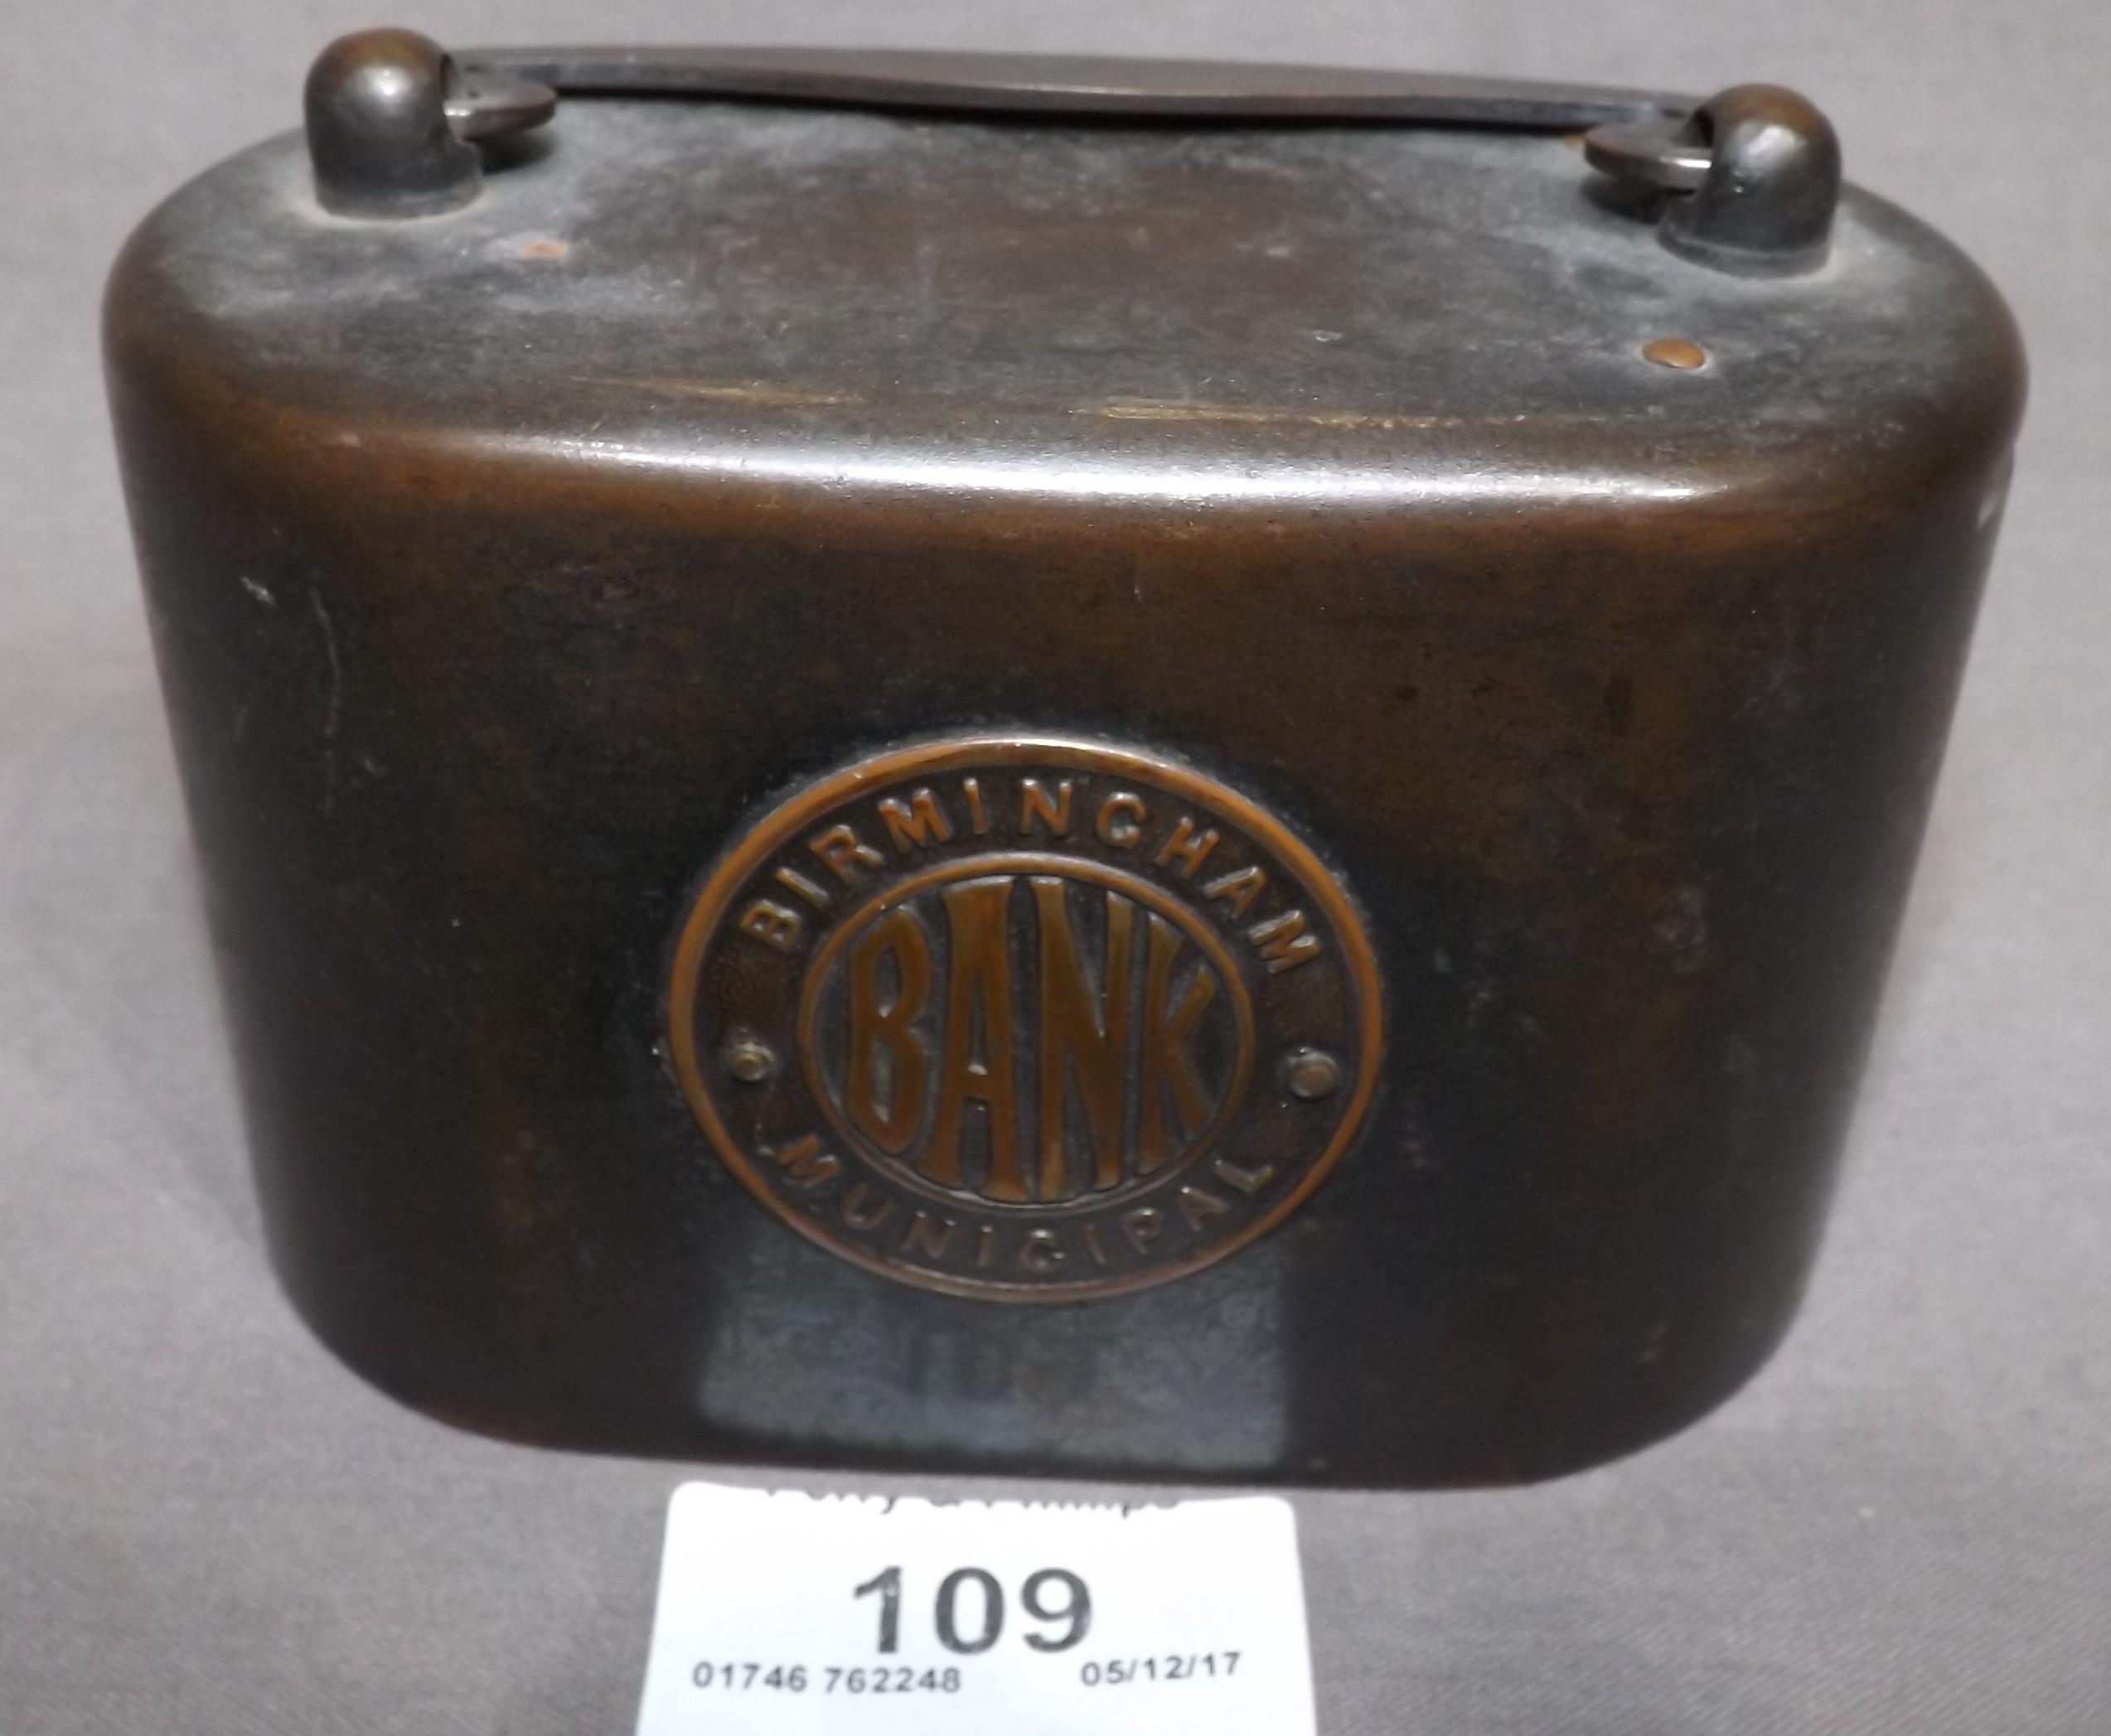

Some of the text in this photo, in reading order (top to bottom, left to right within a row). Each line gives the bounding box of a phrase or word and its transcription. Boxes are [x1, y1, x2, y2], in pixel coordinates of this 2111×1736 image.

[739, 777, 1320, 975] BIRMINGHAM
[846, 876, 1217, 1203] BANK
[776, 1133, 1276, 1273] MUNICIPAL
[854, 1566, 1092, 1656] 109
[1082, 1651, 1241, 1685] 05/12/17
[693, 1661, 961, 1693] 01746 762248
